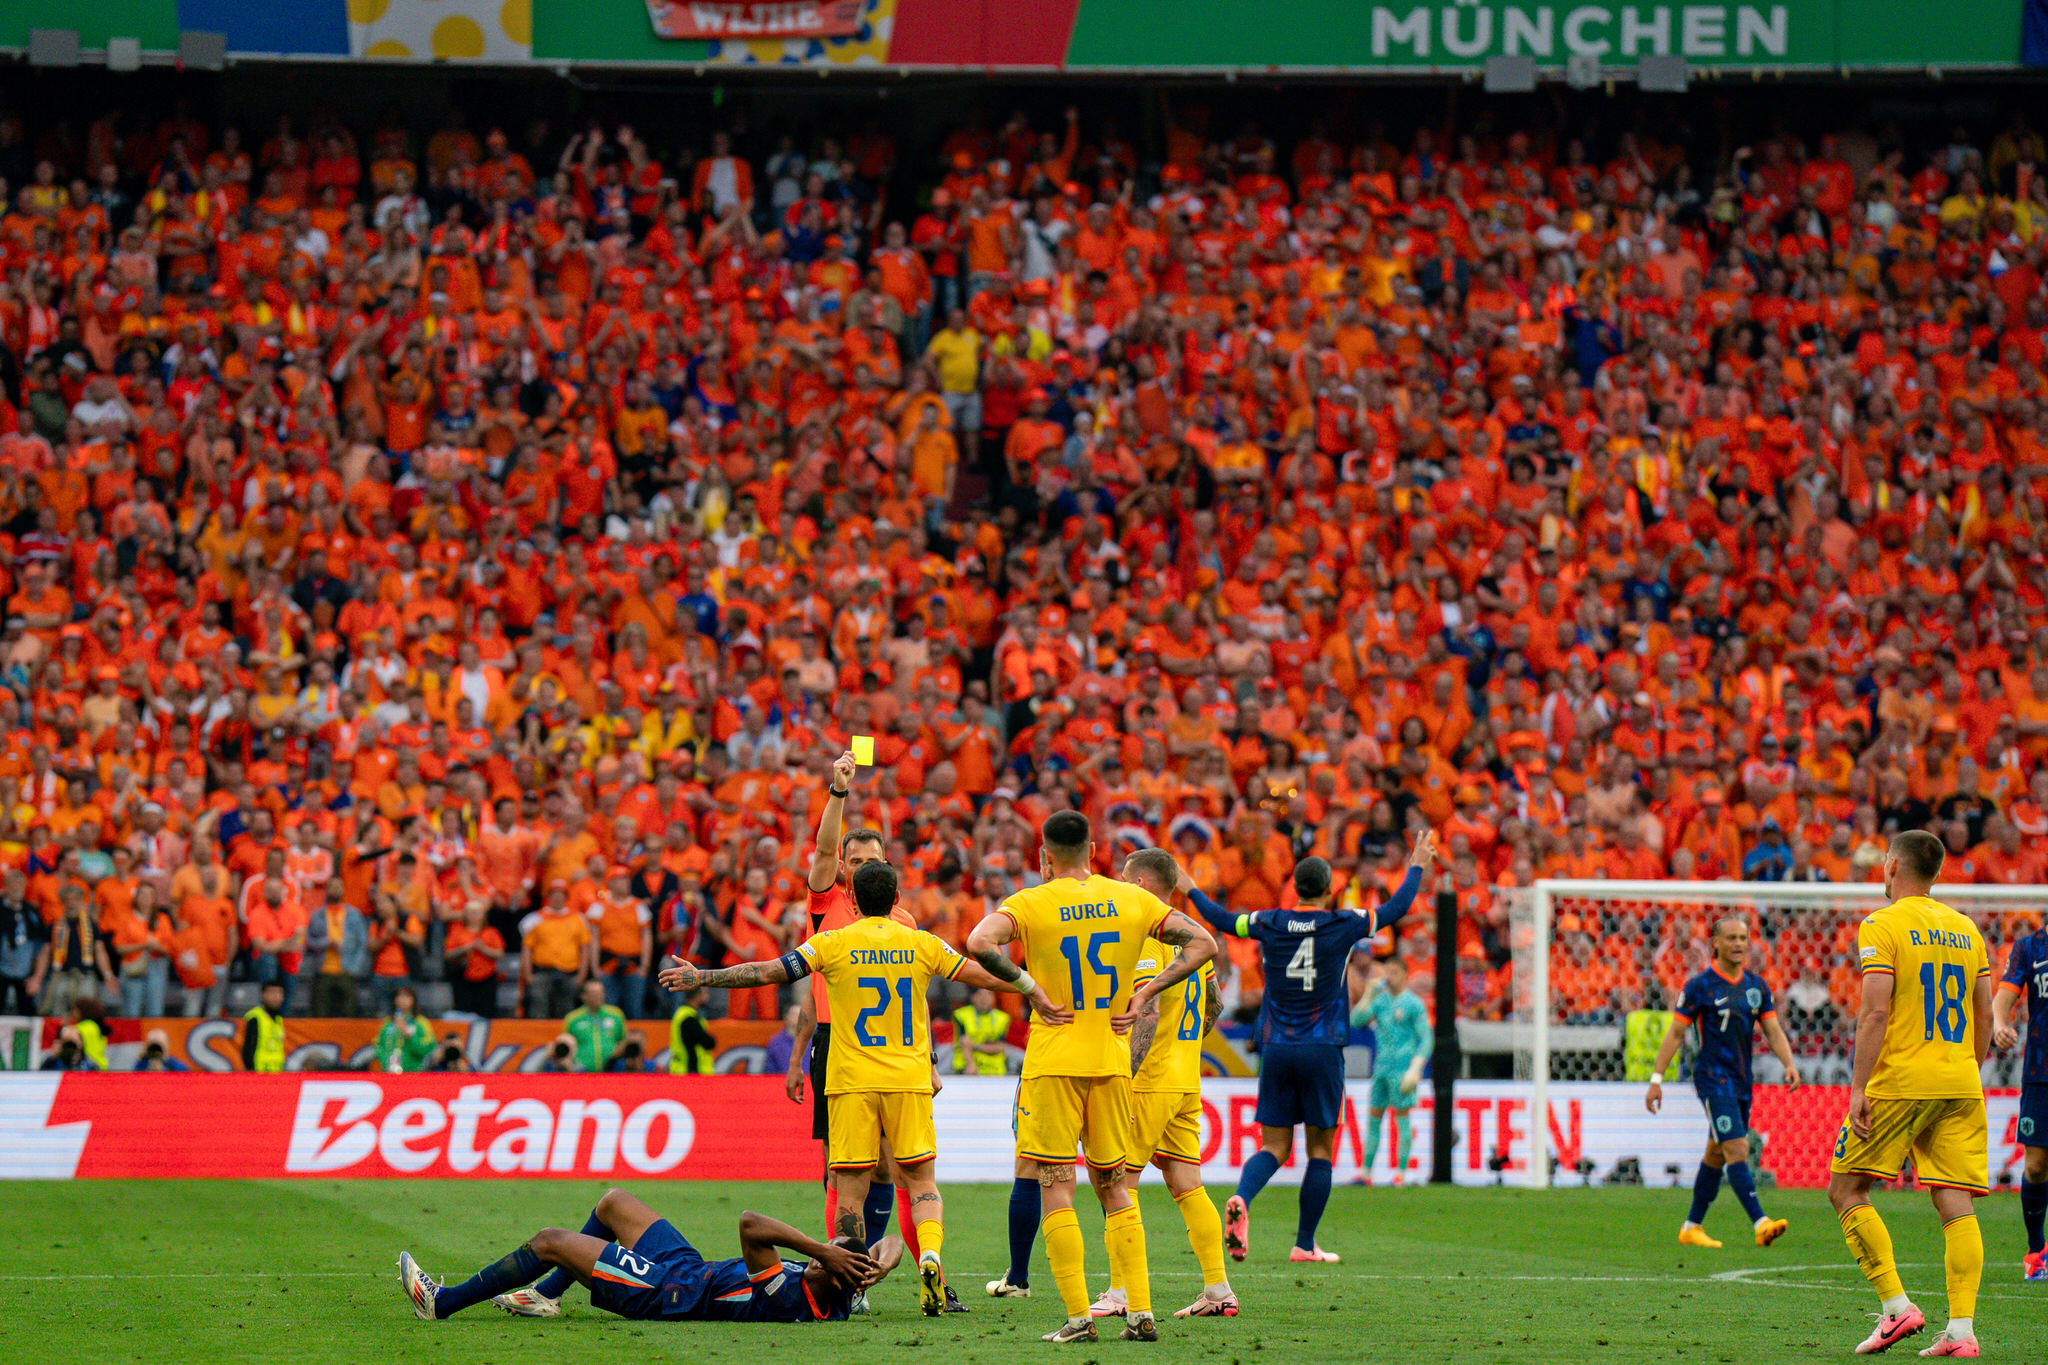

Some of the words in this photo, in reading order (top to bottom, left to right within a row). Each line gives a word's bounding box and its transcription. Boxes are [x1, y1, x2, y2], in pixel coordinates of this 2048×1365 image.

[1370, 0, 1788, 57] MÜNCHEN
[1059, 899, 1119, 922] BURCĂ
[1287, 919, 1317, 933] VIRGIL
[850, 949, 915, 965] STANCIU
[1059, 931, 1121, 1010] 15
[1285, 936, 1318, 991] 4
[853, 977, 914, 1047] 21
[1177, 970, 1202, 1041] 8
[1717, 1008, 1731, 1033] 7
[1919, 962, 1968, 1044] 18
[285, 1080, 697, 1174] Betano
